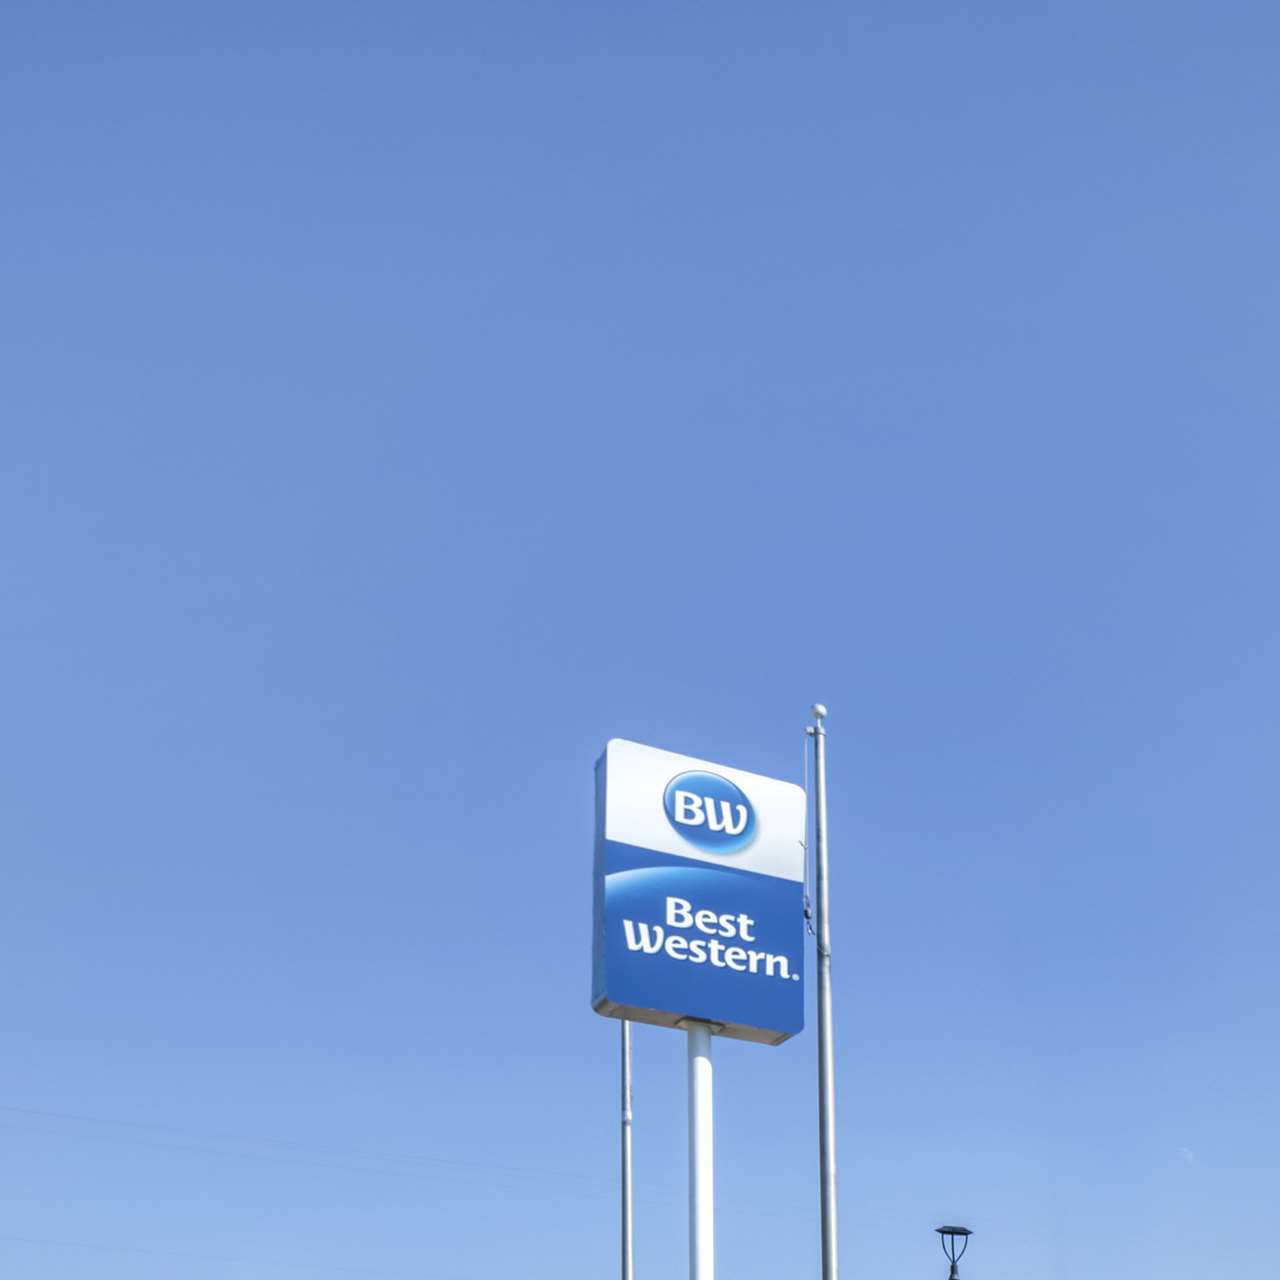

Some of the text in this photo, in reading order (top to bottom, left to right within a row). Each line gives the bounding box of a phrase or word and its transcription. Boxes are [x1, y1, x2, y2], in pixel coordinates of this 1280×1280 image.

[674, 790, 747, 835] BW
[666, 896, 755, 942] Best
[623, 919, 792, 979] Western
